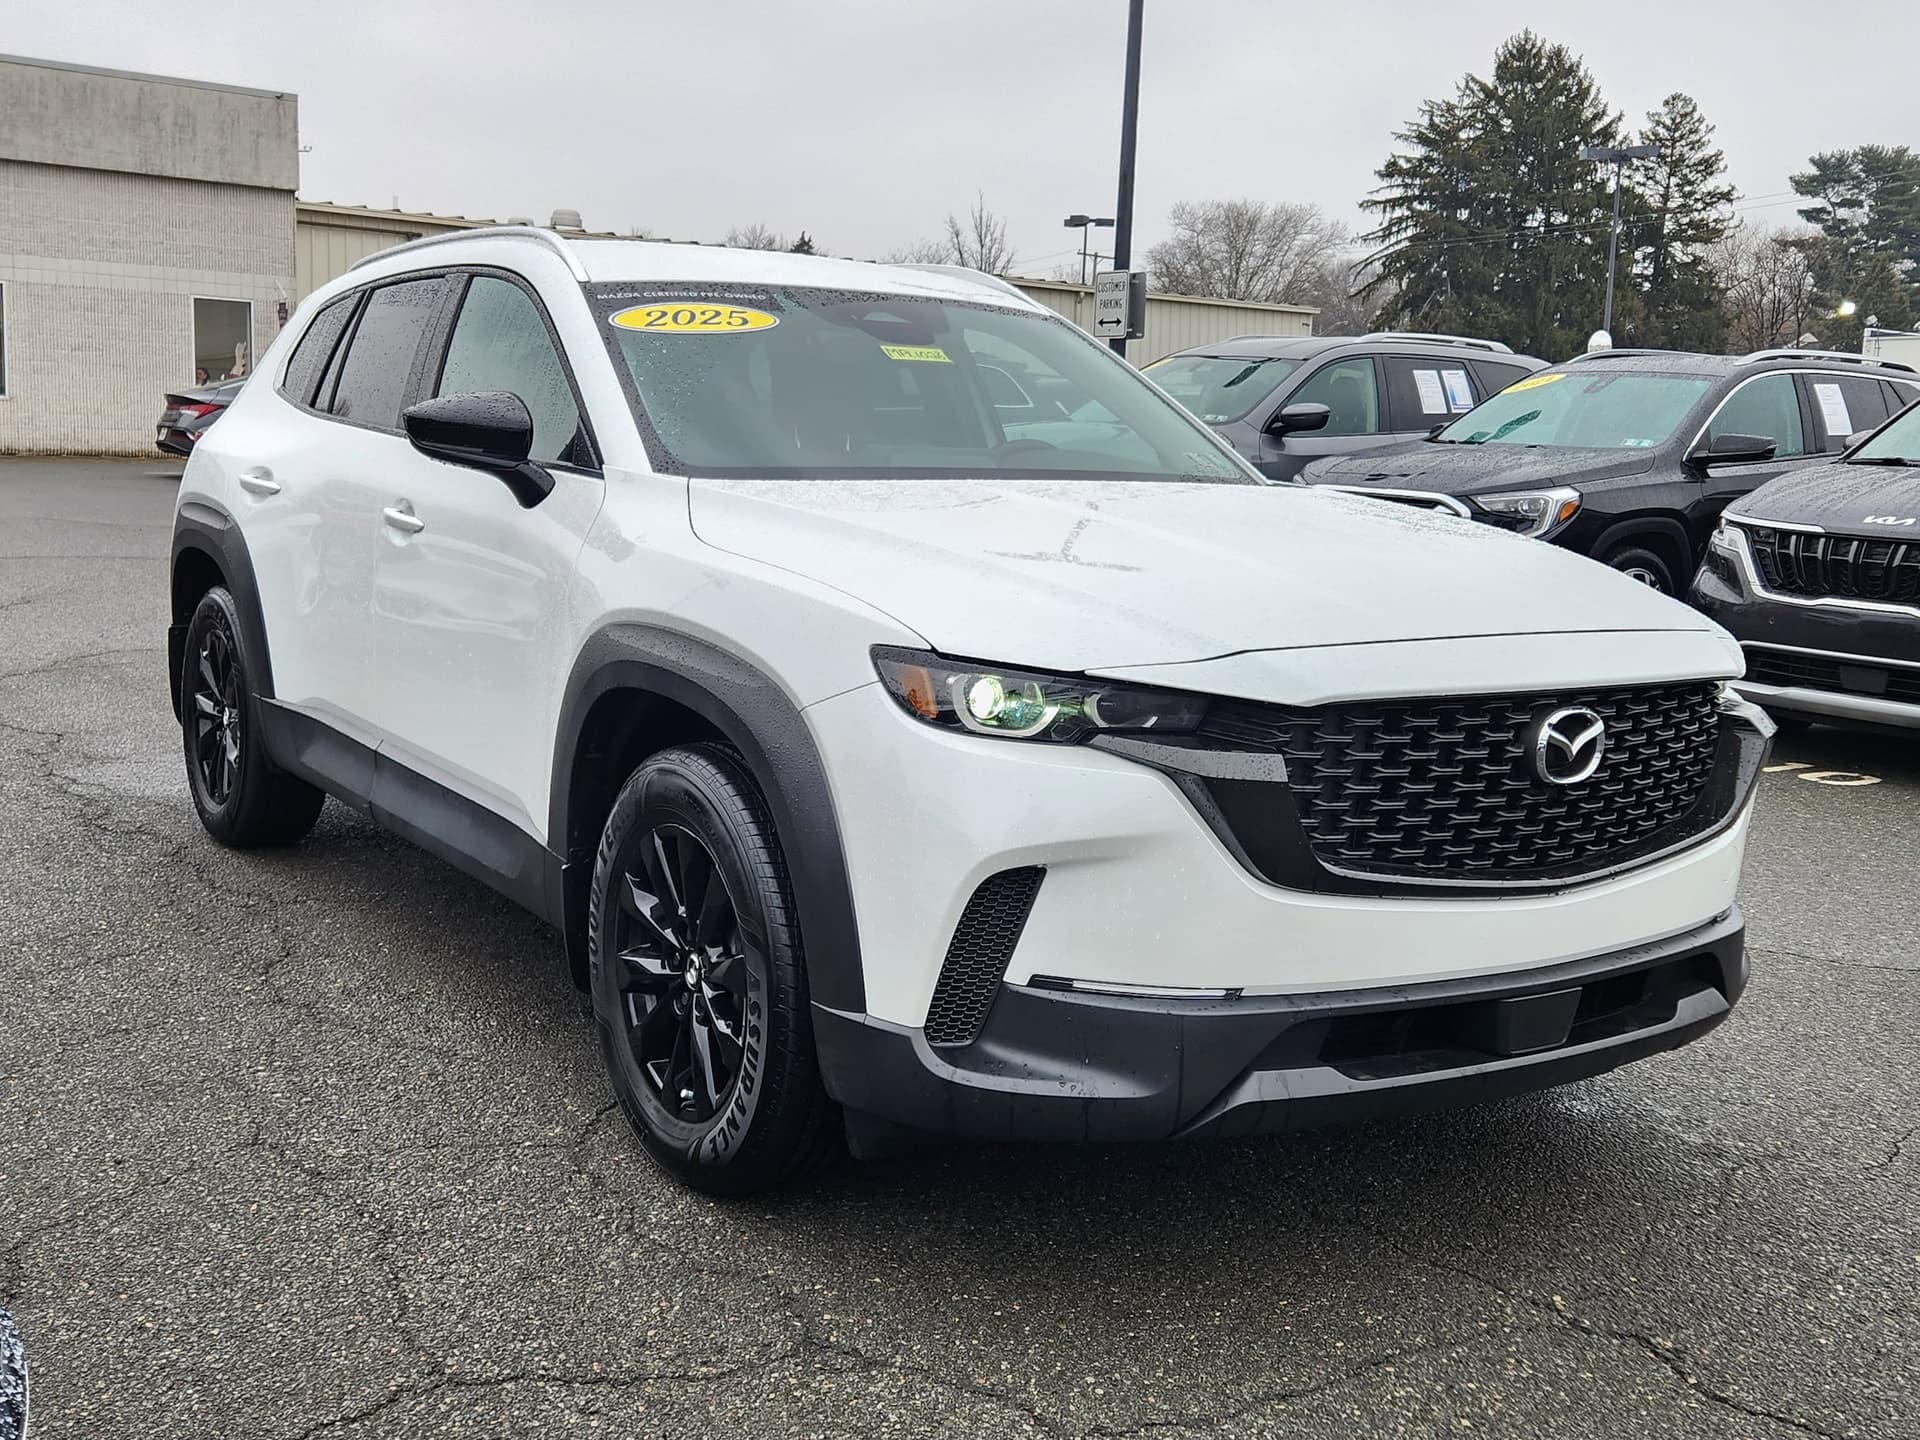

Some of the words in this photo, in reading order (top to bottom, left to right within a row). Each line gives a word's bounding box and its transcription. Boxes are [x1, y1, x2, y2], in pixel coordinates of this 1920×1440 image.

[1098, 281, 1126, 294] CUSTOMER
[597, 292, 641, 300] MAZDA
[700, 291, 767, 300] PRE-OWNED
[1099, 298, 1123, 310] PARKING
[644, 309, 749, 328] 2025
[709, 970, 762, 1160] ASSURANCE
